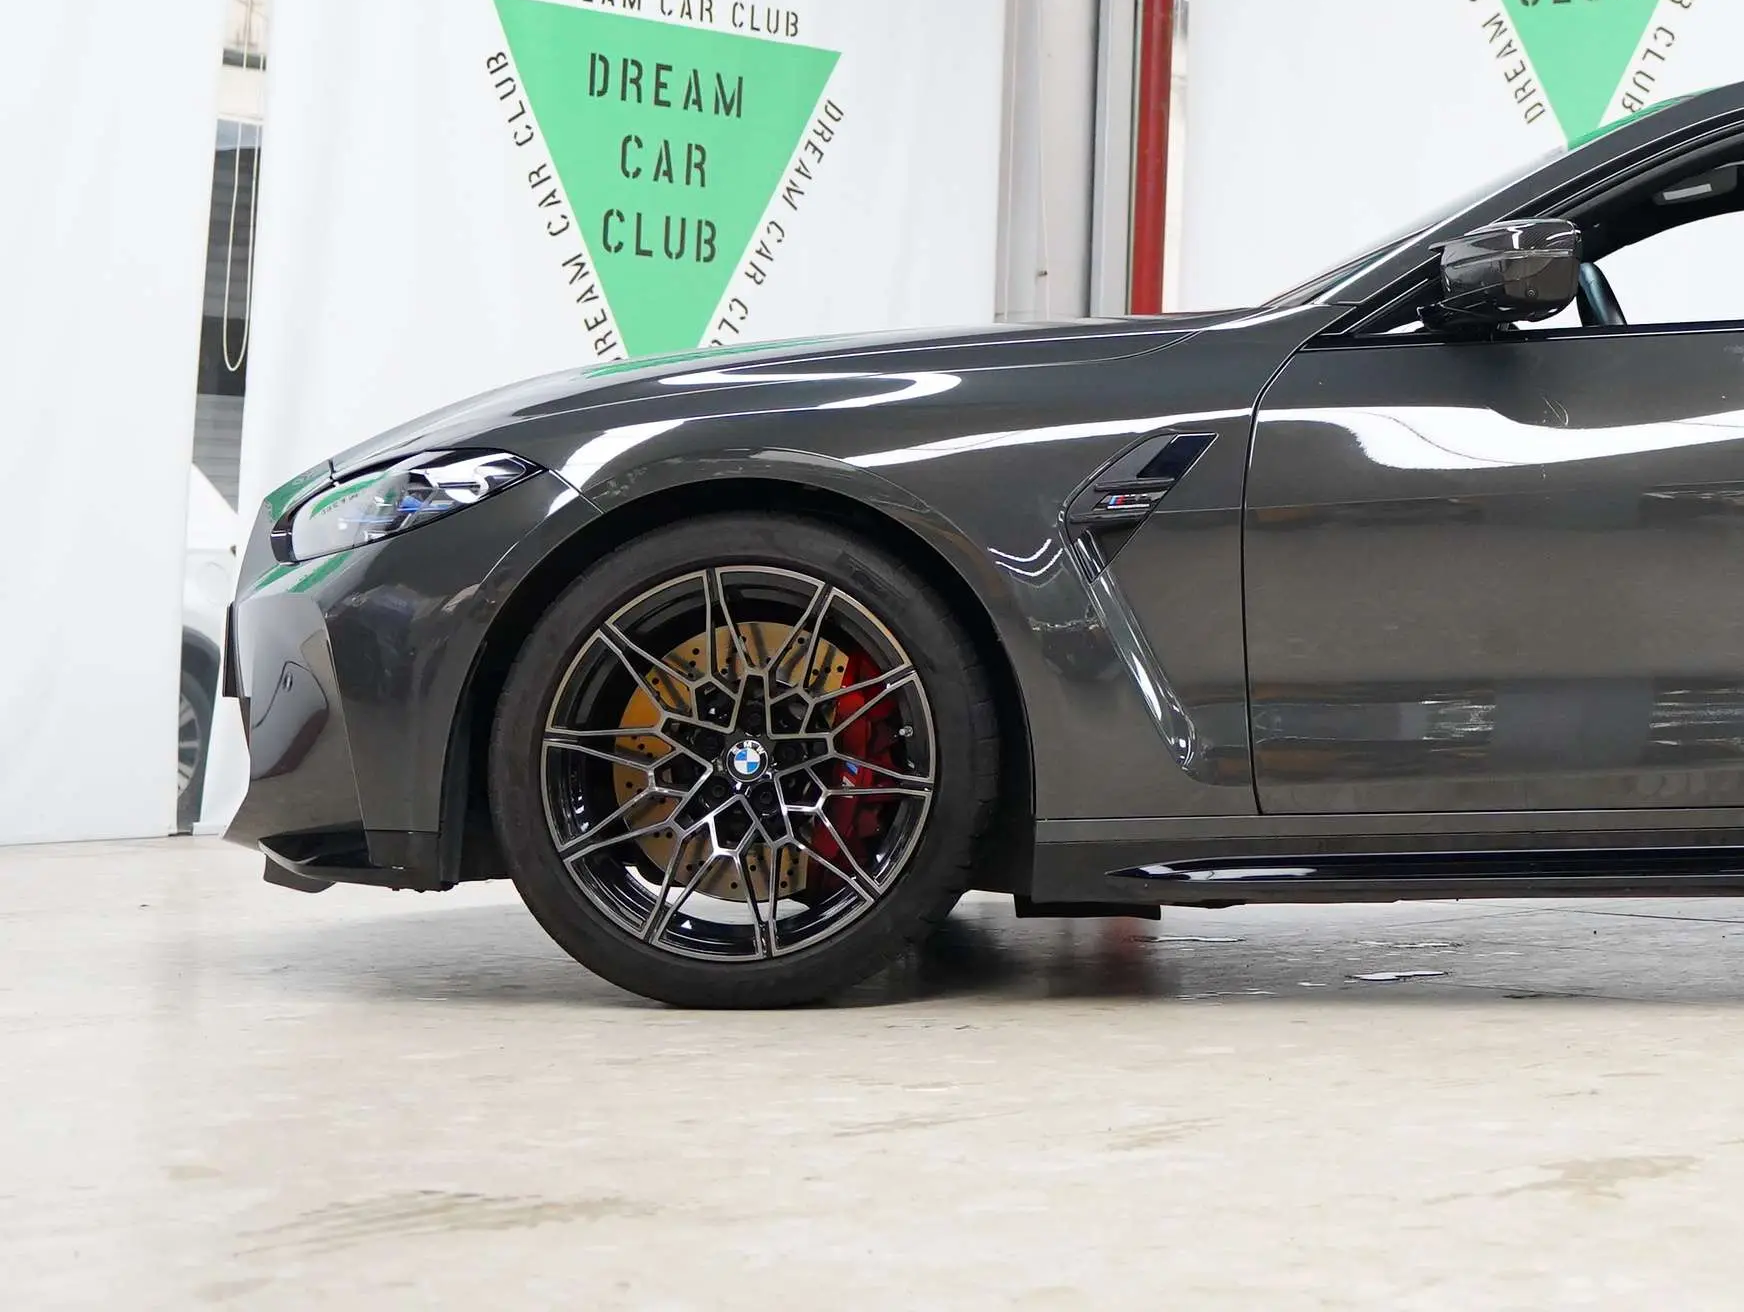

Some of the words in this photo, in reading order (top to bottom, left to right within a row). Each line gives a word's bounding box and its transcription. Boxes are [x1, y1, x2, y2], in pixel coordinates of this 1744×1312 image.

[731, 1, 799, 38] CLUB
[486, 51, 534, 147] CLUB
[588, 52, 744, 119] DREAM
[1482, 12, 1545, 124] DREAM
[1621, 26, 1675, 113] CLUB
[620, 134, 707, 188] CAR
[782, 99, 844, 211] DREAM
[528, 163, 570, 237] CAR
[602, 208, 717, 263] CLUB
[744, 220, 785, 286] CAR
[561, 253, 622, 361] REAM
